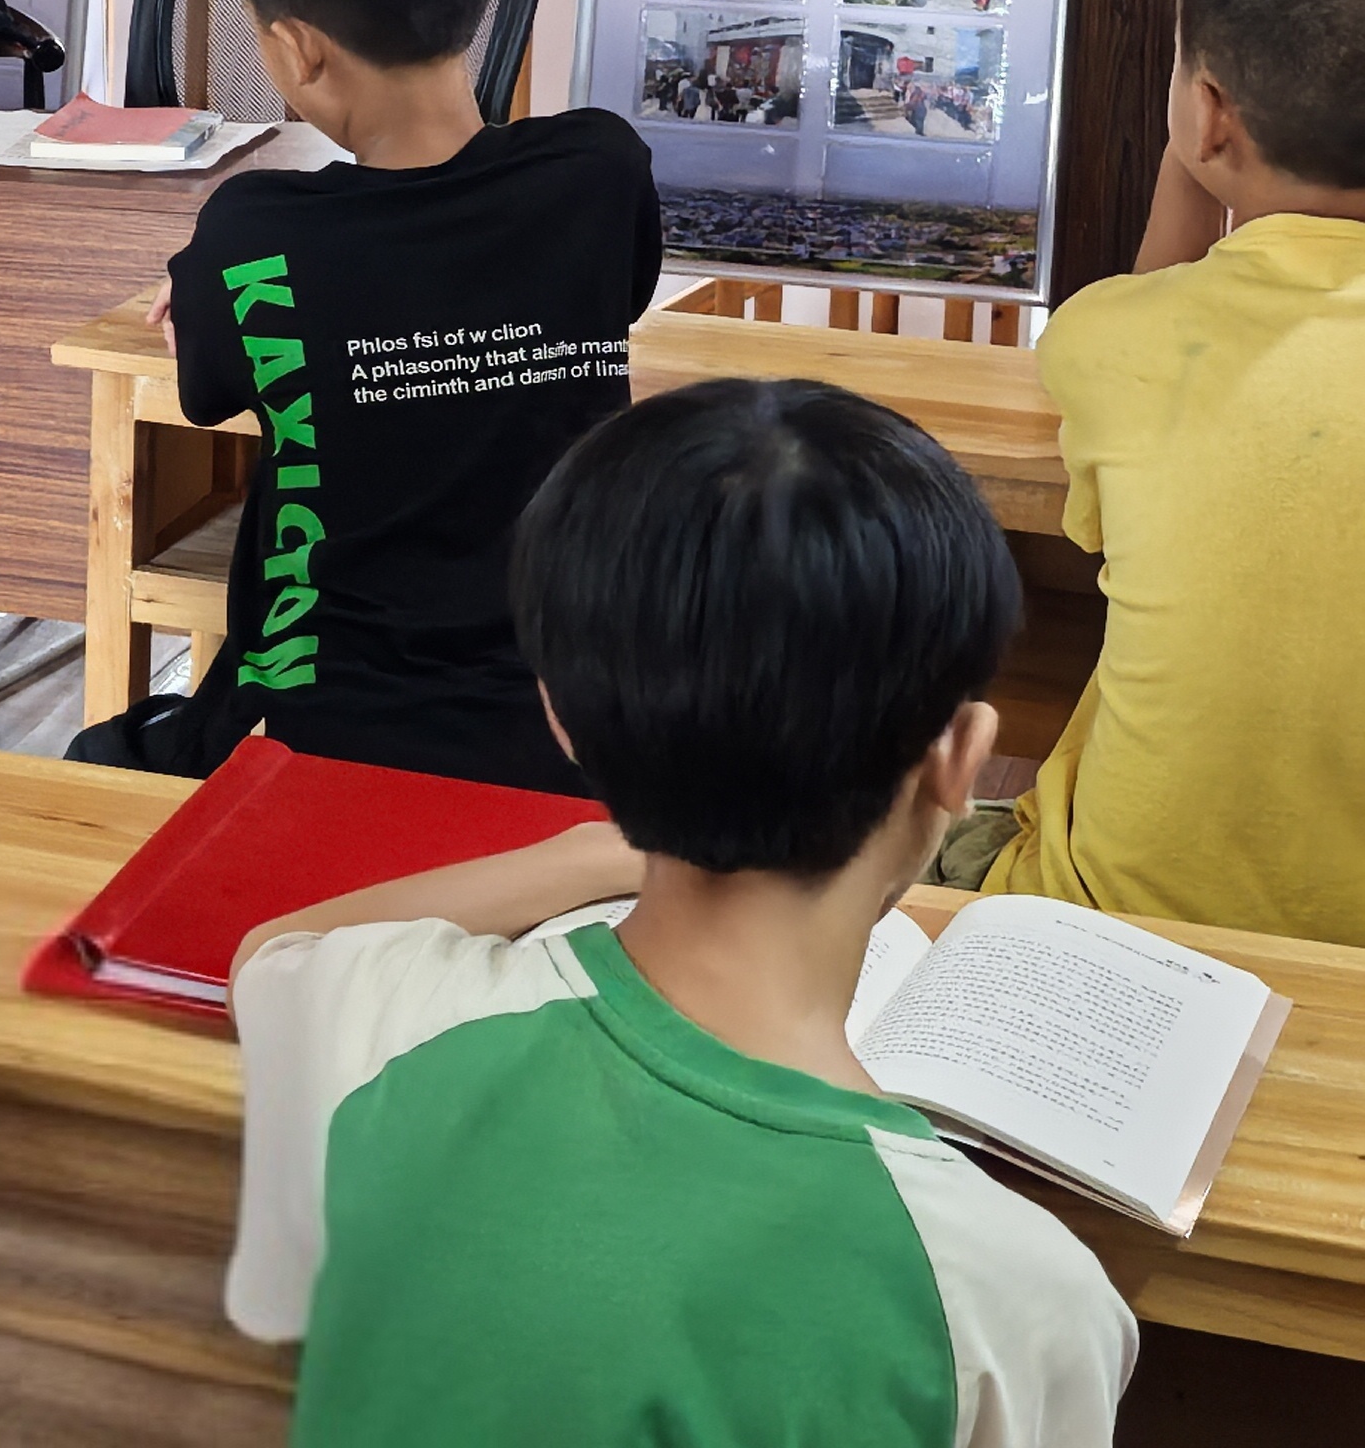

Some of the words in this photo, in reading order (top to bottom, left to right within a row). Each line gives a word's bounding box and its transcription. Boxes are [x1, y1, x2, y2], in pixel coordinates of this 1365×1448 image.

[347, 335, 408, 358] Phlos
[413, 331, 439, 350] fsi
[444, 328, 466, 346] of
[491, 321, 543, 342] clion
[351, 364, 368, 381] A
[485, 347, 527, 367] that
[353, 387, 388, 404] the
[474, 372, 515, 392] and
[571, 360, 592, 378] of
